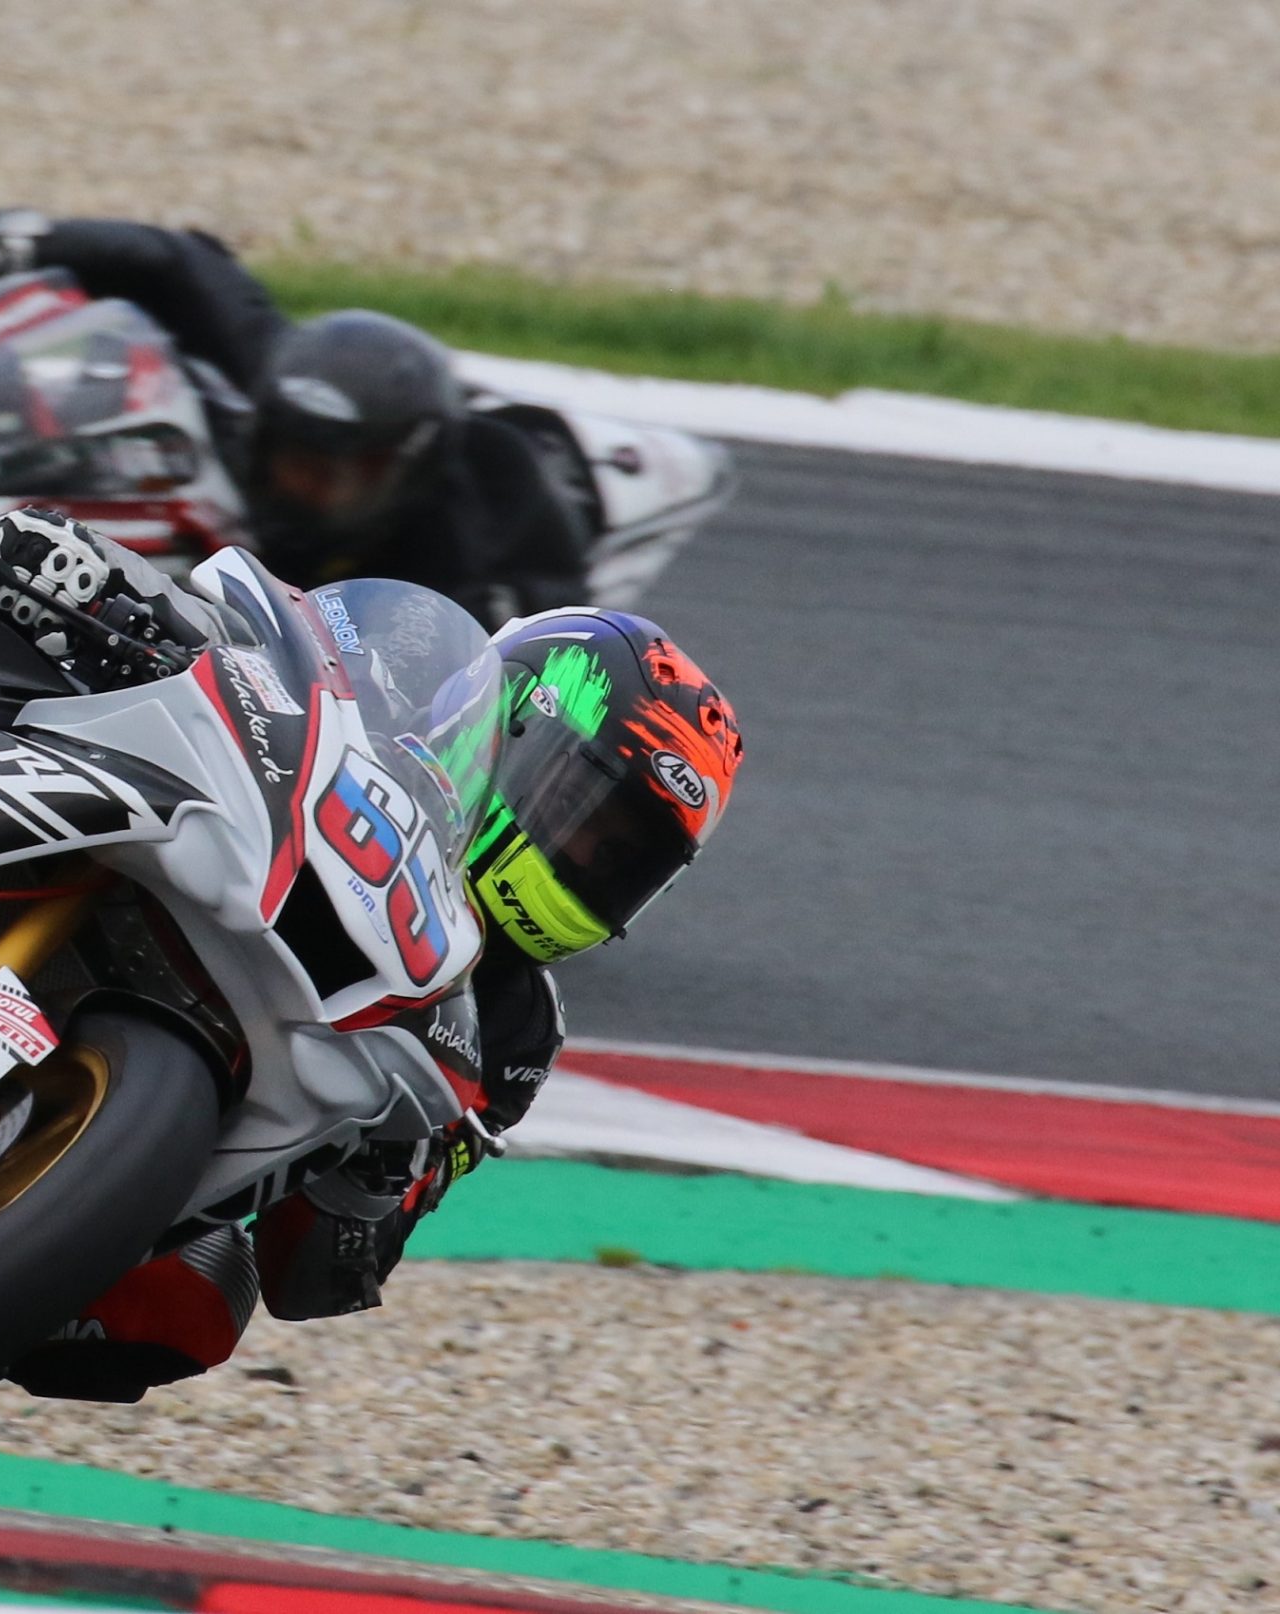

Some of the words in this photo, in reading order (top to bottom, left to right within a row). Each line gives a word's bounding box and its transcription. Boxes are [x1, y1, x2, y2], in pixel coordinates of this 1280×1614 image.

[315, 589, 365, 655] LEONOV
[657, 762, 704, 803] Arai
[314, 744, 457, 988] 65
